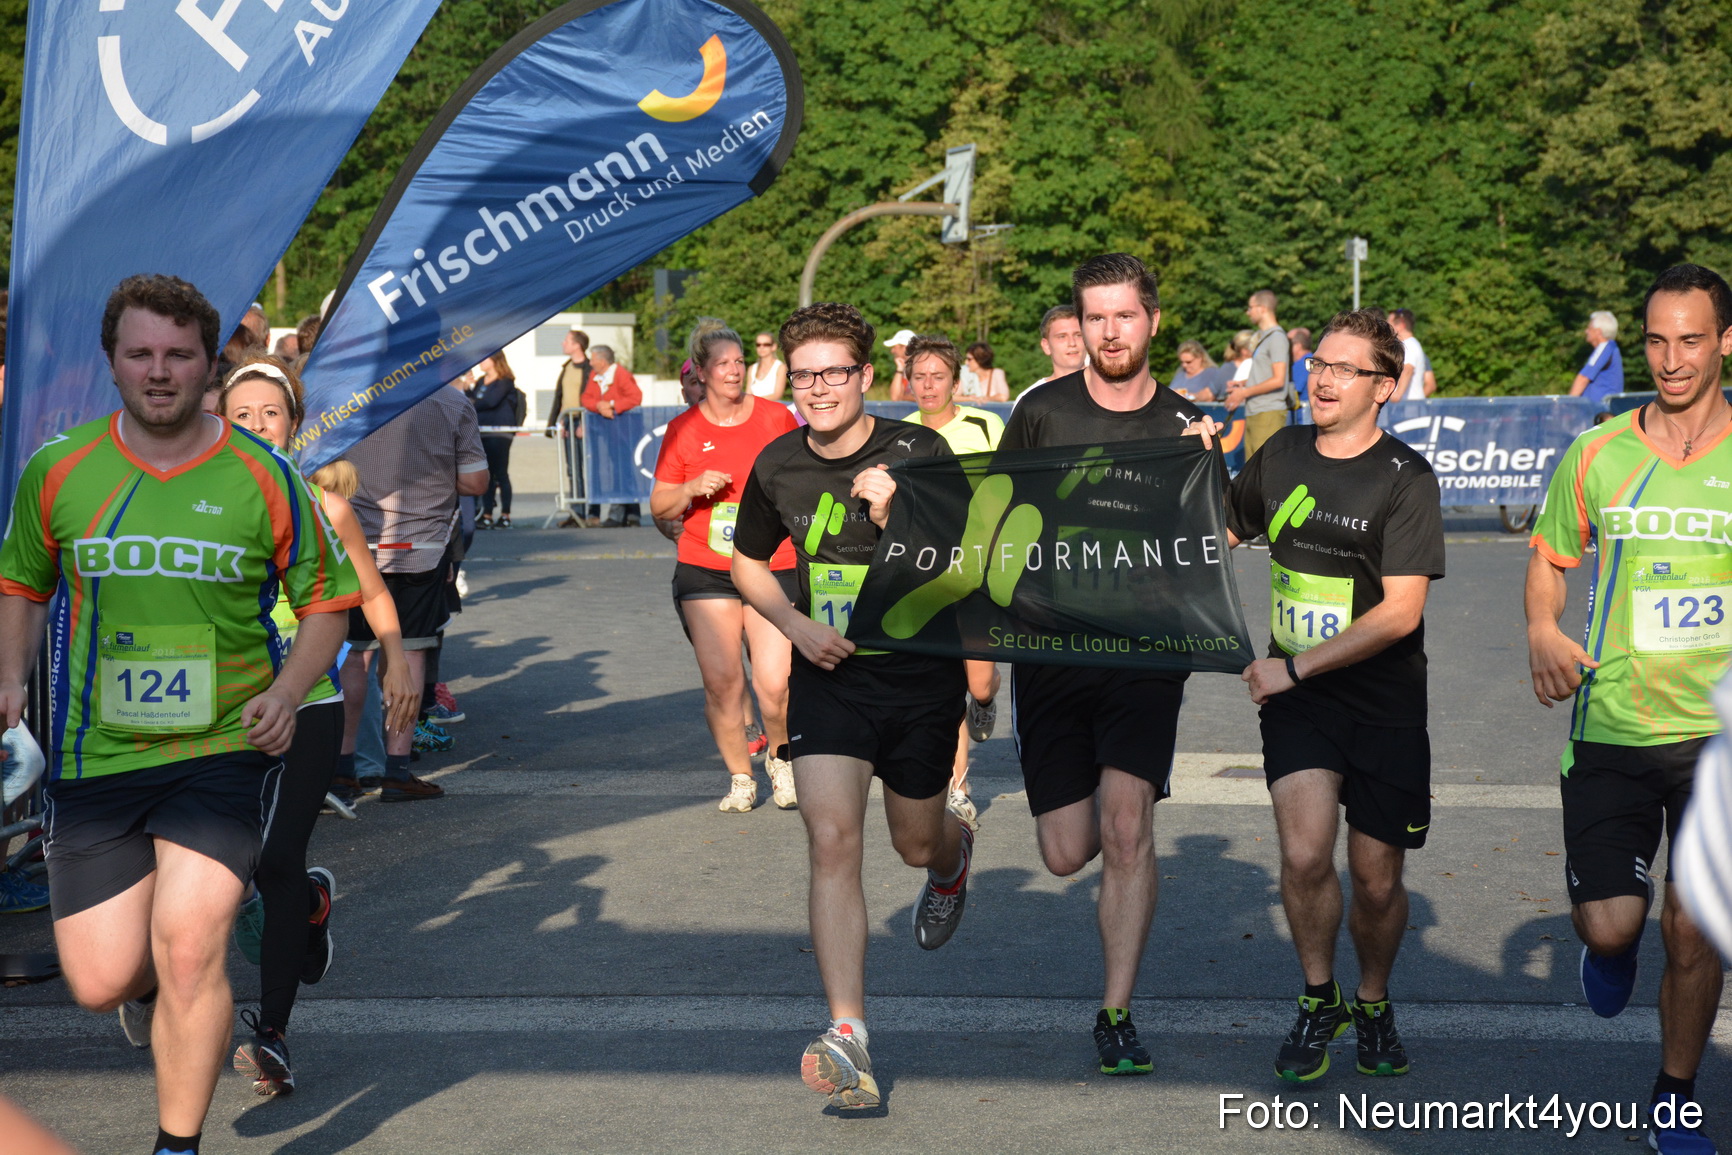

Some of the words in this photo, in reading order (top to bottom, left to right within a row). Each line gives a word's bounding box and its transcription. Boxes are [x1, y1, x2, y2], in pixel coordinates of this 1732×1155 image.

[564, 190, 636, 243] Druck
[637, 164, 685, 199] und
[684, 110, 772, 175] Medien
[367, 132, 668, 325] Frischmann
[793, 511, 872, 527] PORTFORM
[1599, 506, 1732, 546] BOCK
[73, 535, 246, 583] BOCK
[836, 545, 858, 553] Secure
[884, 535, 1221, 575] PORTFORMANCE
[1292, 538, 1315, 551] Secure
[1315, 545, 1332, 555] Cloud
[1333, 547, 1366, 560] Solutions
[822, 578, 856, 588] firmenlauf
[1645, 572, 1687, 581] firmenlauf
[1276, 599, 1340, 641] 1118
[1654, 594, 1725, 628] 123
[110, 643, 151, 653] firmenlauf
[988, 626, 1064, 651] Secure
[1070, 633, 1131, 653] Cloud
[1138, 632, 1241, 653] Solutions
[1659, 634, 1702, 644] Christopher
[1702, 632, 1721, 640] Groß
[117, 668, 191, 703] 124
[116, 709, 139, 719] Pascal
[140, 711, 191, 719] Haßdenteufel
